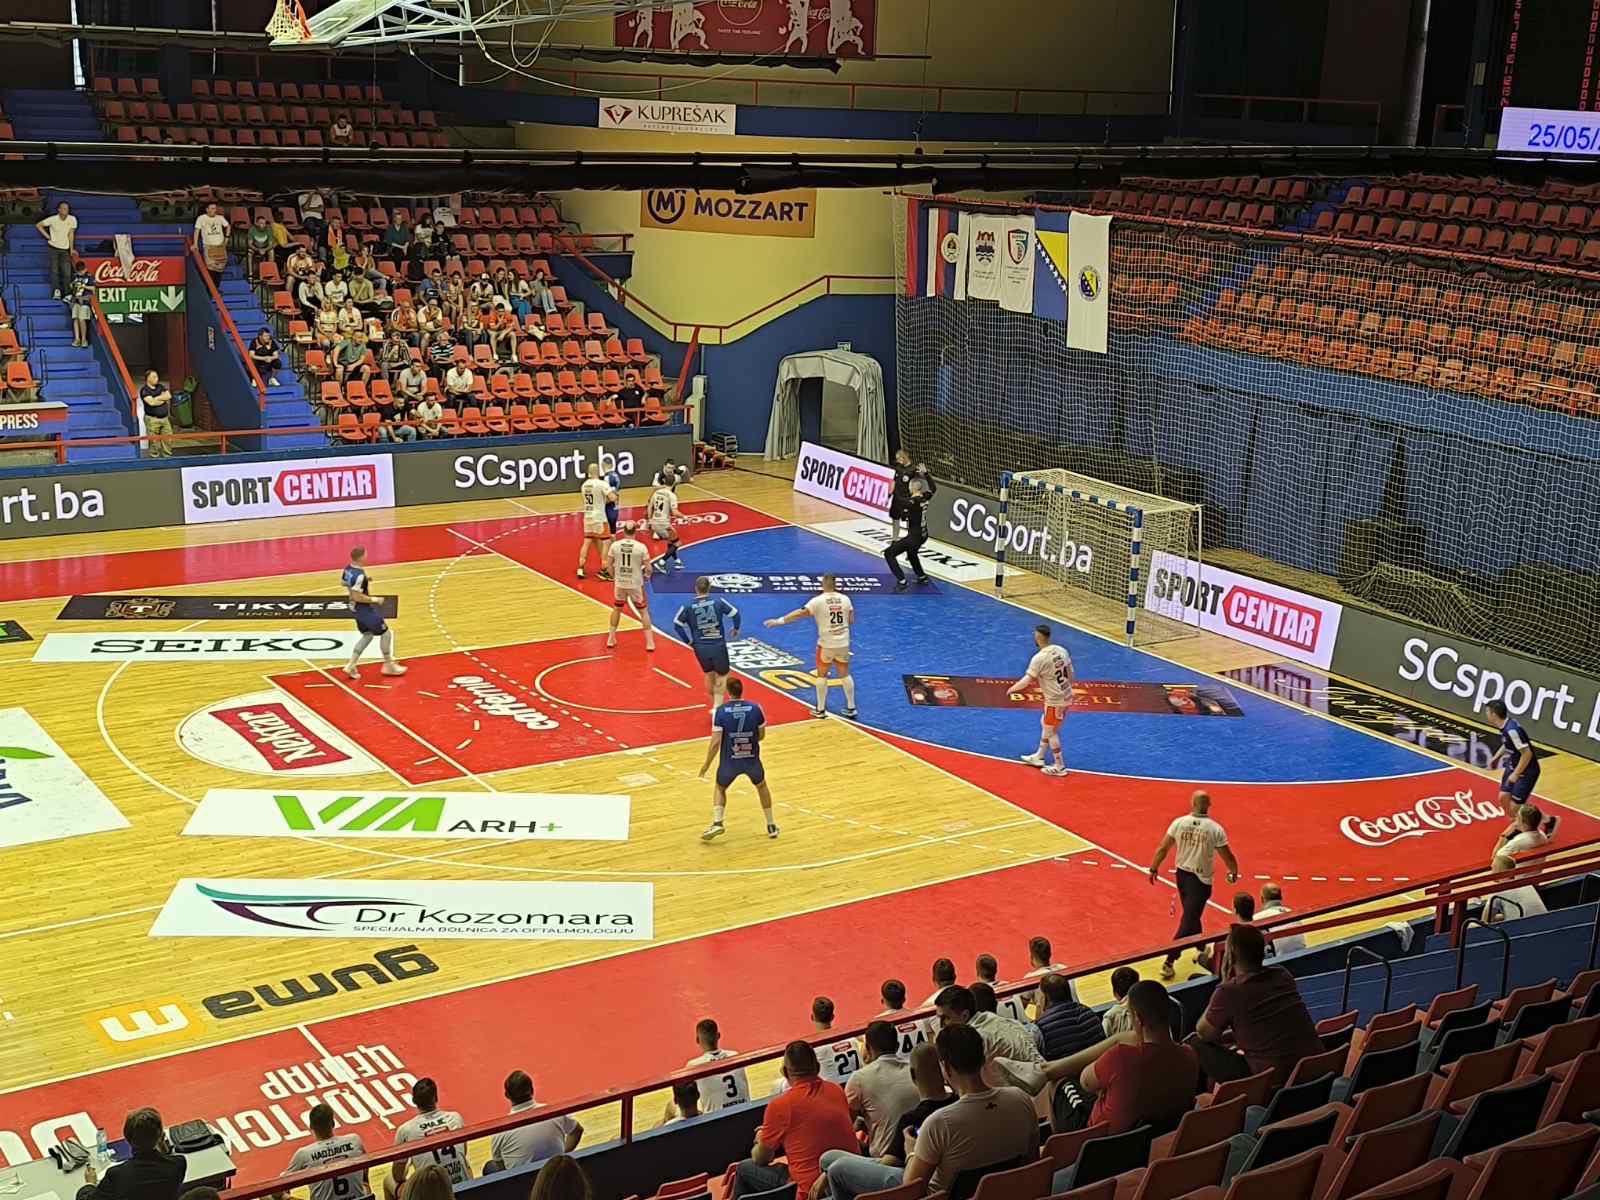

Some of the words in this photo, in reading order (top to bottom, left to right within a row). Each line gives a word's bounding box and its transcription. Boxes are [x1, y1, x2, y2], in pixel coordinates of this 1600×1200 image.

[638, 104, 727, 124] KUPREŠAK
[694, 197, 809, 222] MOZZART
[98, 287, 127, 303] EXIT
[129, 299, 159, 312] IZLAZ
[454, 446, 635, 490] SCsportba
[801, 455, 845, 492] SPORT
[192, 475, 273, 508] SPORT
[282, 469, 374, 501] CENTAR
[0, 483, 105, 525] rt.ba
[621, 553, 631, 567] 11
[213, 601, 350, 610] TIKVEŠ
[1153, 567, 1224, 616] SPORT
[1229, 591, 1317, 647] CENTAR
[829, 611, 843, 625] 26
[90, 637, 344, 654] SEIKO
[1054, 665, 1069, 685] 24
[1009, 692, 1122, 705] BRZIL
[237, 710, 329, 764] Nektar
[1339, 787, 1505, 848] Coca-Cola
[355, 908, 406, 924] Dr
[418, 909, 634, 927] Kozomara
[352, 925, 435, 933] SPECIJALNA
[201, 944, 440, 1020] guma
[833, 1049, 860, 1076] 27
[723, 1074, 738, 1098] 3
[333, 1176, 349, 1196] 6
